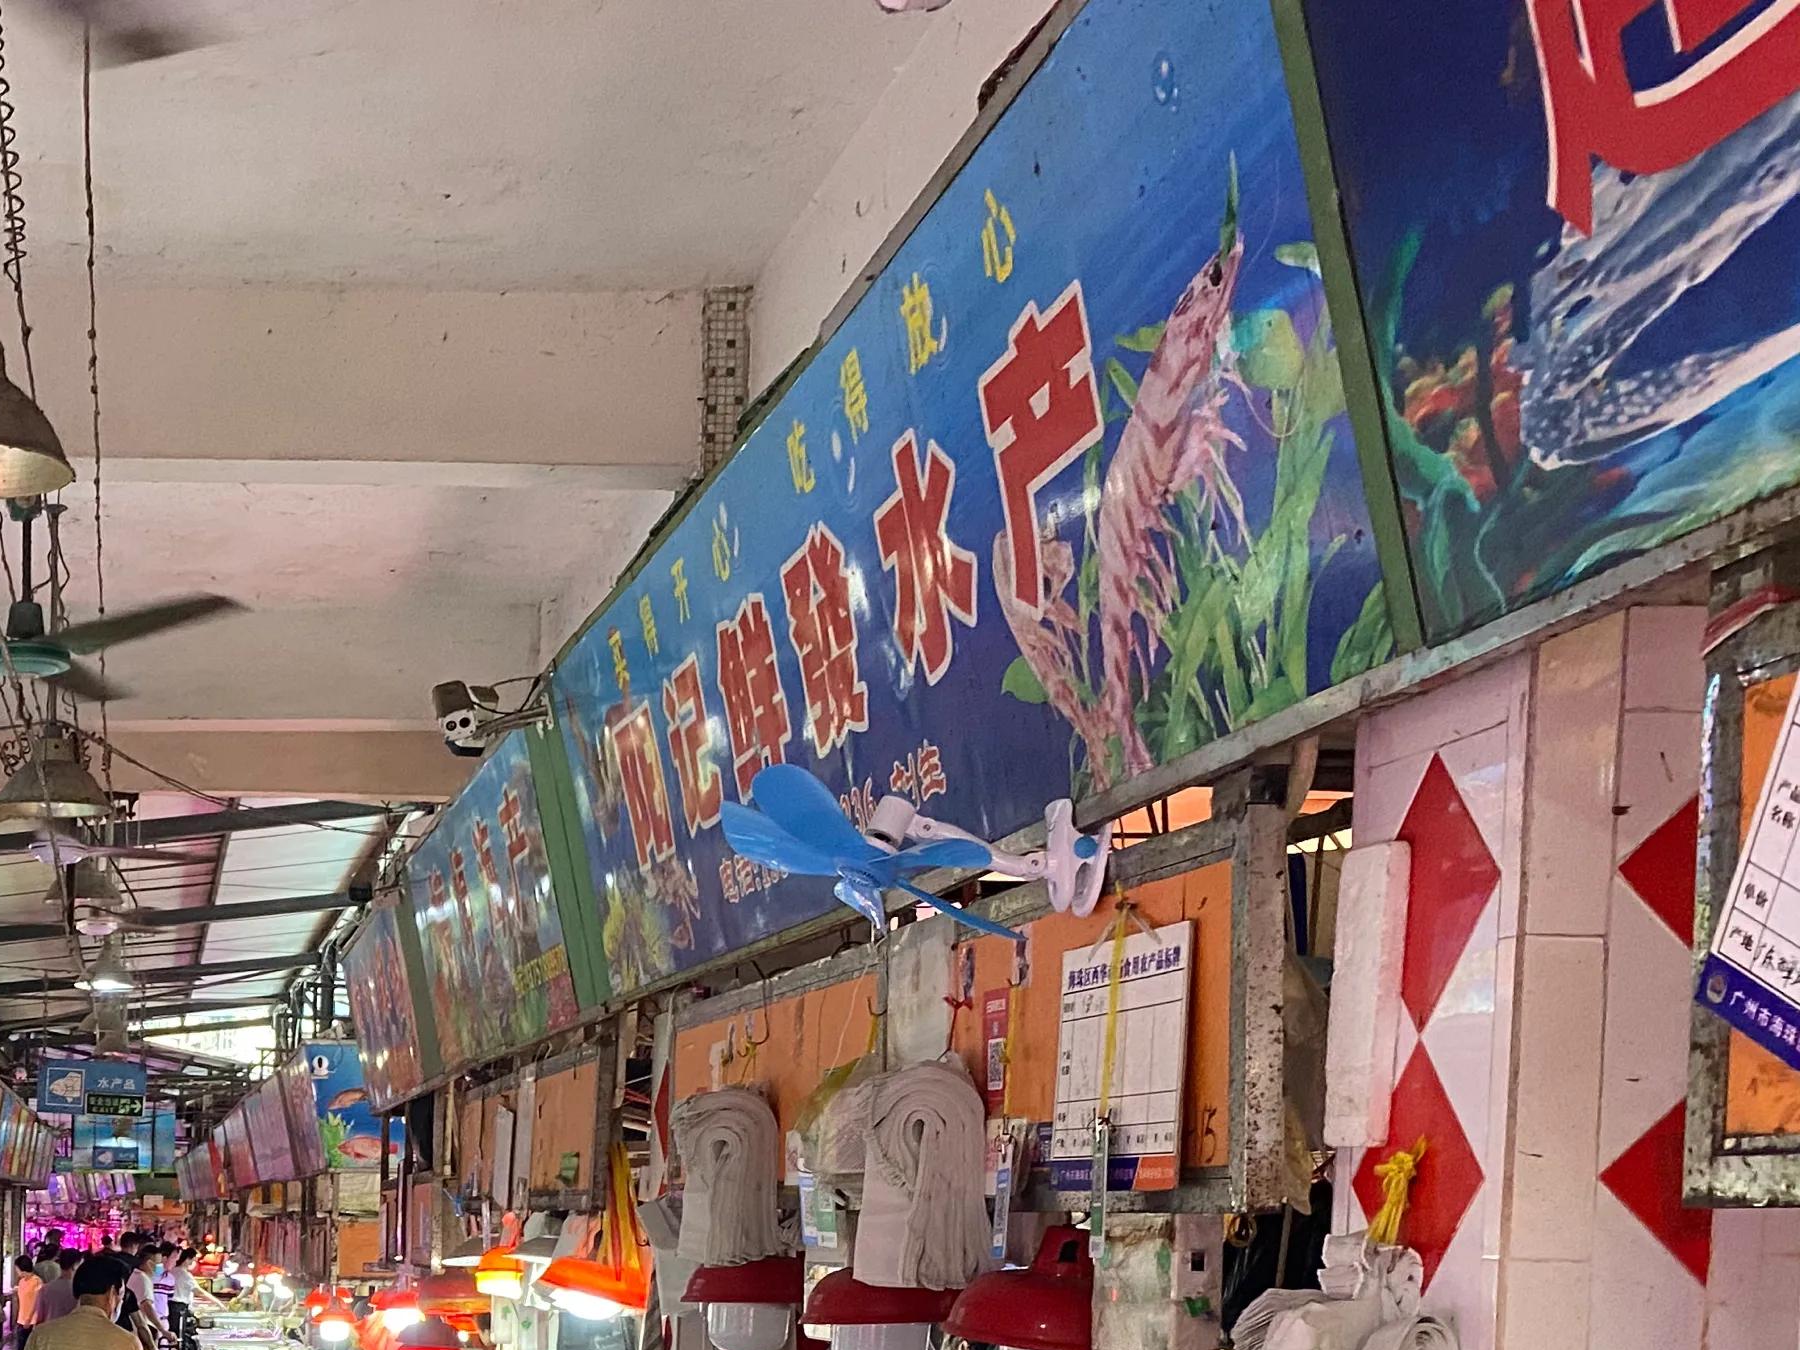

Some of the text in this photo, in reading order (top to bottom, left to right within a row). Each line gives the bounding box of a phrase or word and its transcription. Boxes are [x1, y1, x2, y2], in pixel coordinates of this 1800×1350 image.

[608, 190, 1016, 692] 买得开心 吃得放心
[1728, 989, 1800, 1053] 广州市海珠
[97, 1076, 136, 1090] 水产品
